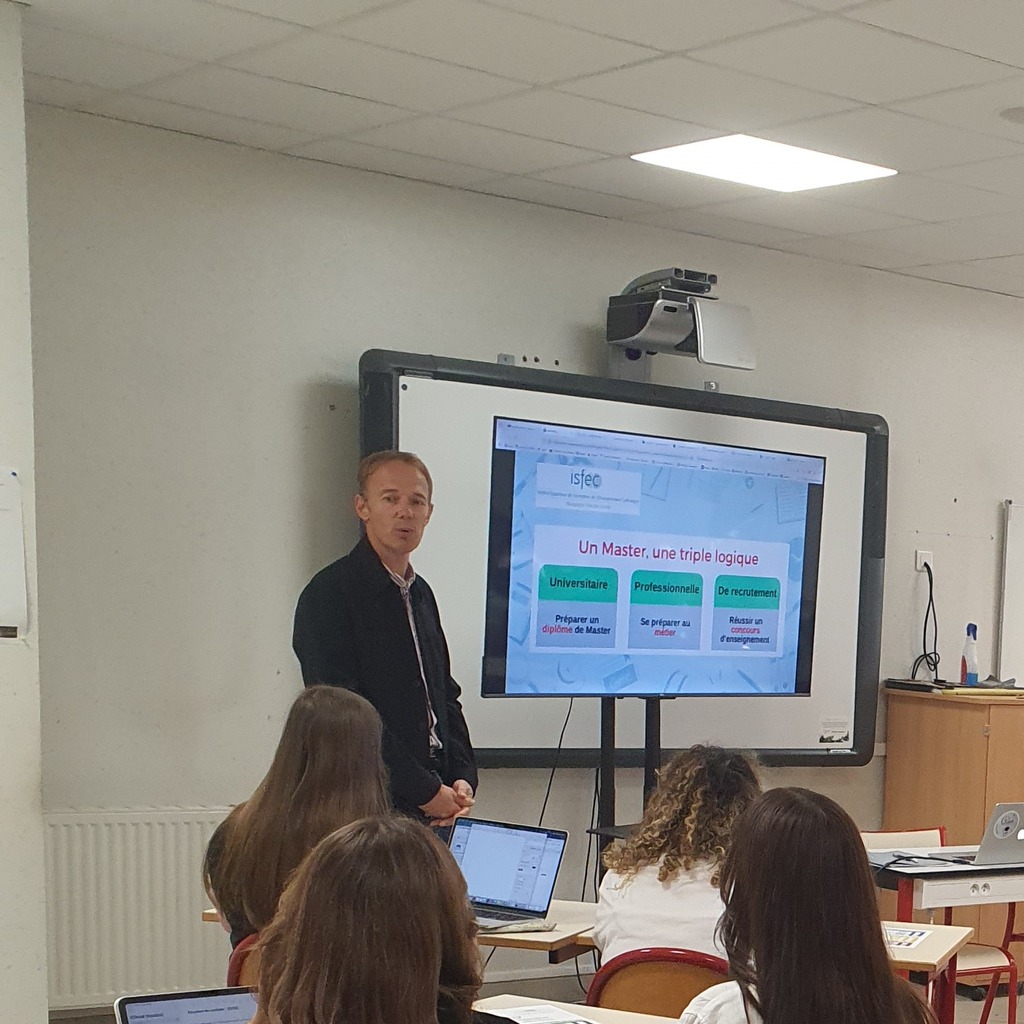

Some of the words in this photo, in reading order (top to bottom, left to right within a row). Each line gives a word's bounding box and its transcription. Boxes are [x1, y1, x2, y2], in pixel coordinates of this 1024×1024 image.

[579, 540, 598, 555] Un
[602, 541, 649, 559] Master,
[652, 547, 676, 560] une
[679, 547, 712, 564] triple
[715, 549, 759, 567] logique
[549, 577, 608, 590] Universitaire
[634, 581, 700, 595] Professionnelle
[718, 585, 729, 596] De
[730, 587, 777, 598] recrutement
[555, 614, 588, 625] Préparer
[589, 616, 600, 624] un
[640, 617, 650, 626] Se
[651, 618, 680, 629] préparer
[729, 616, 754, 625] Réussir
[754, 617, 763, 625] un
[541, 624, 573, 635] diplôme
[574, 625, 584, 634] de
[585, 625, 611, 635] Master
[730, 626, 761, 635] concours
[720, 635, 770, 645] d'enseignement
